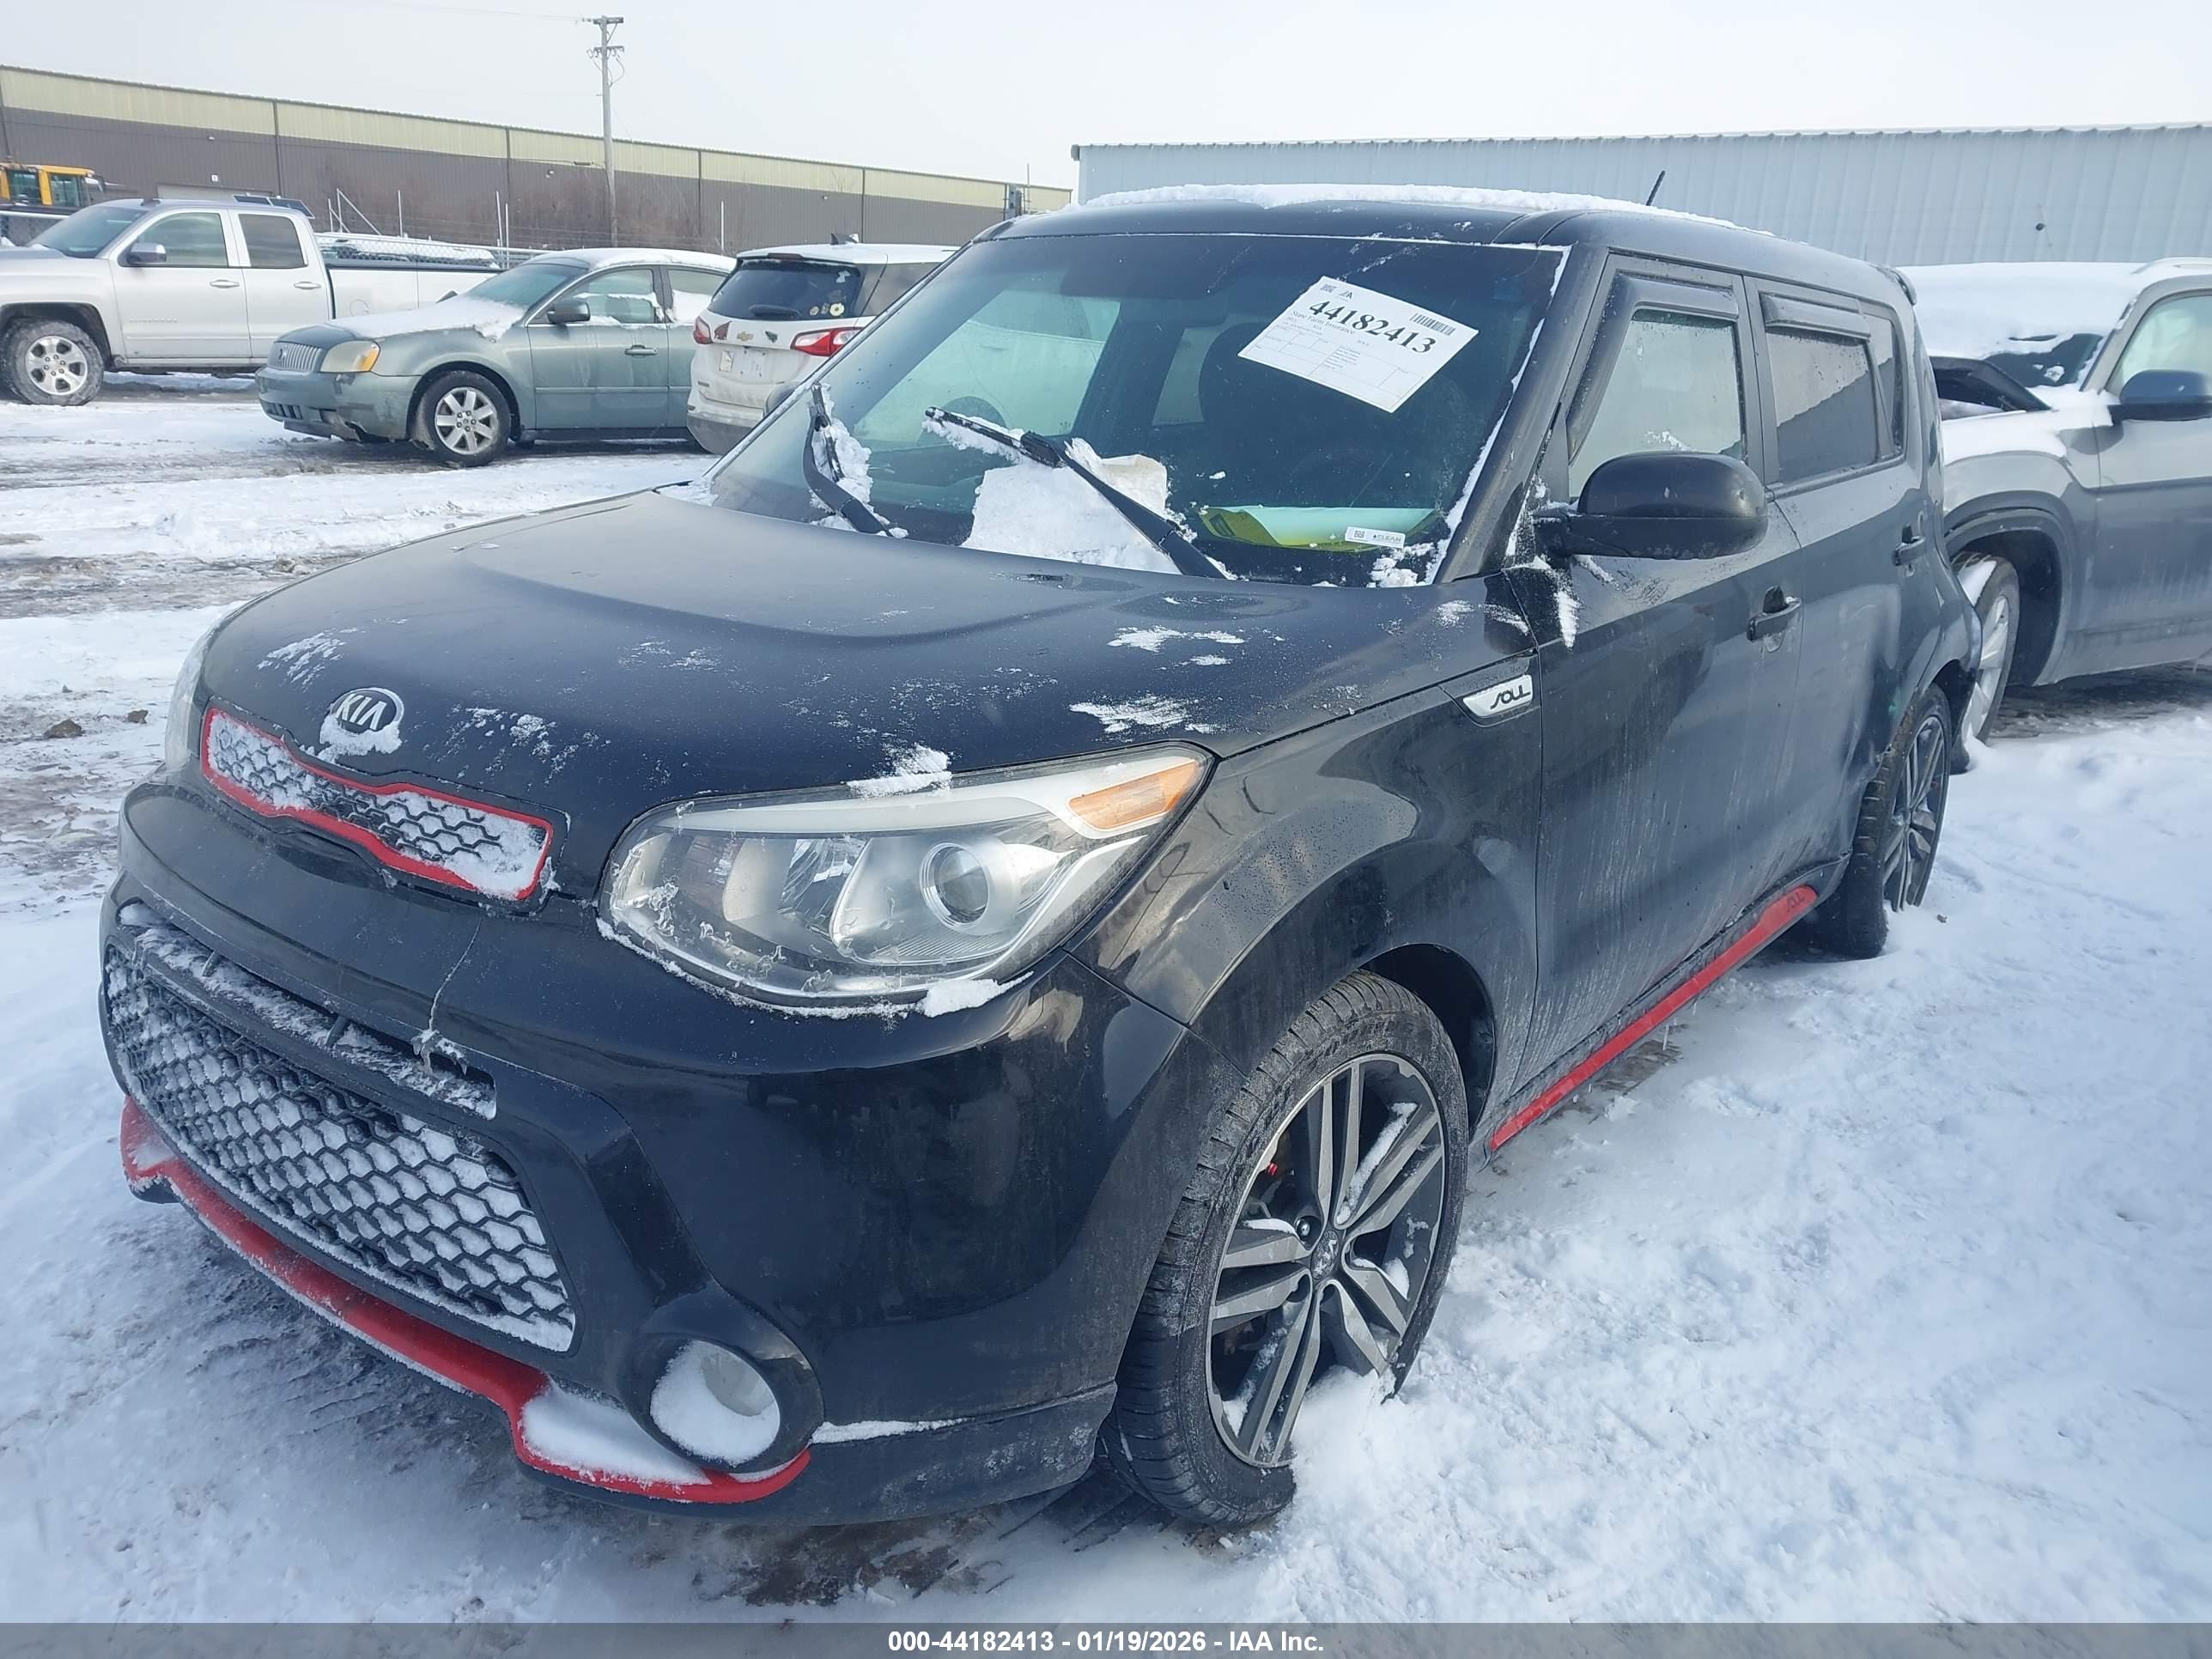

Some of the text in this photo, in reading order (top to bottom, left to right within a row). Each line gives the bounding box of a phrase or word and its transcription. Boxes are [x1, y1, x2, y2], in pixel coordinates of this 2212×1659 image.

[1307, 315, 1323, 325] Farm
[1325, 321, 1355, 335] Insurance
[1310, 301, 1437, 353] 44182413
[336, 693, 387, 731] KIA
